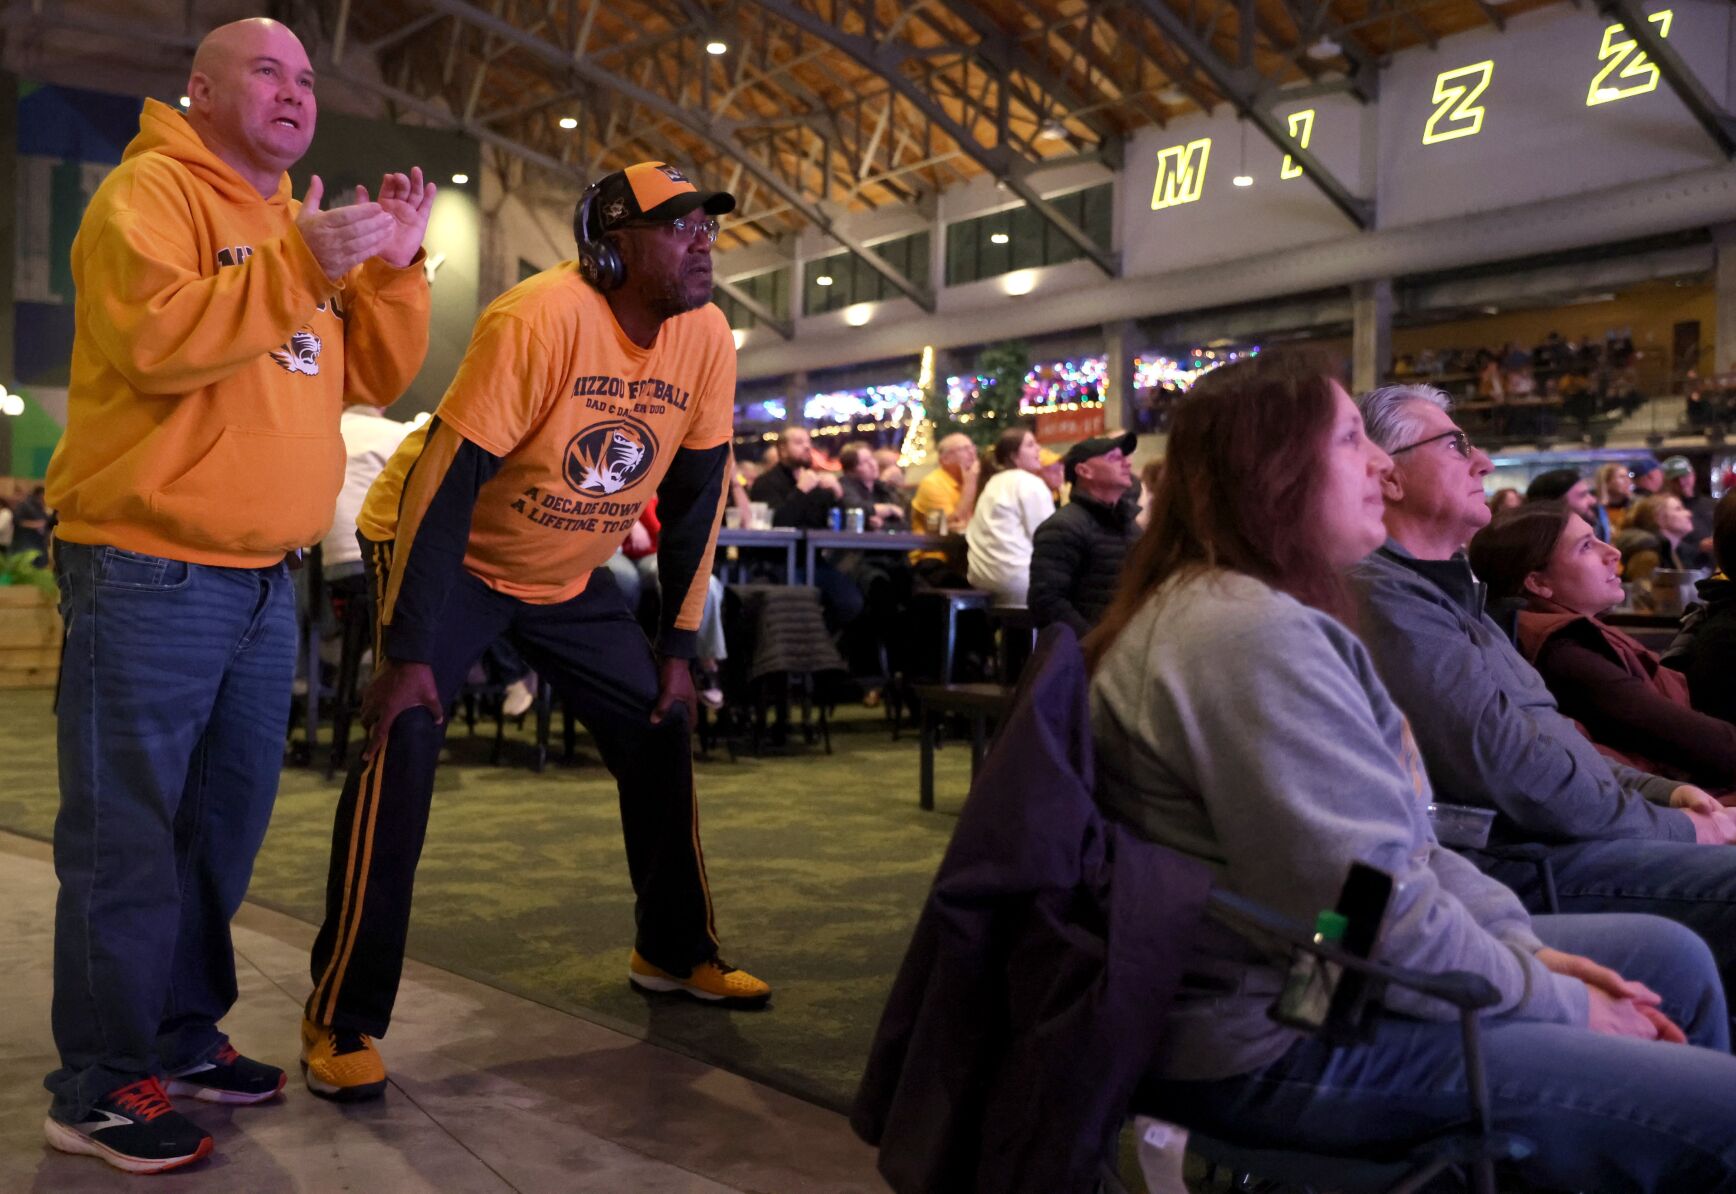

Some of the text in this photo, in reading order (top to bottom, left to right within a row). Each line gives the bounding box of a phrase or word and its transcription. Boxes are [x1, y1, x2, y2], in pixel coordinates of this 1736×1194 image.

[586, 398, 607, 412] DAD
[650, 404, 666, 415] DUO
[511, 499, 525, 514] A
[602, 519, 620, 534] TO
[524, 488, 642, 517] A DECADE DOWN
